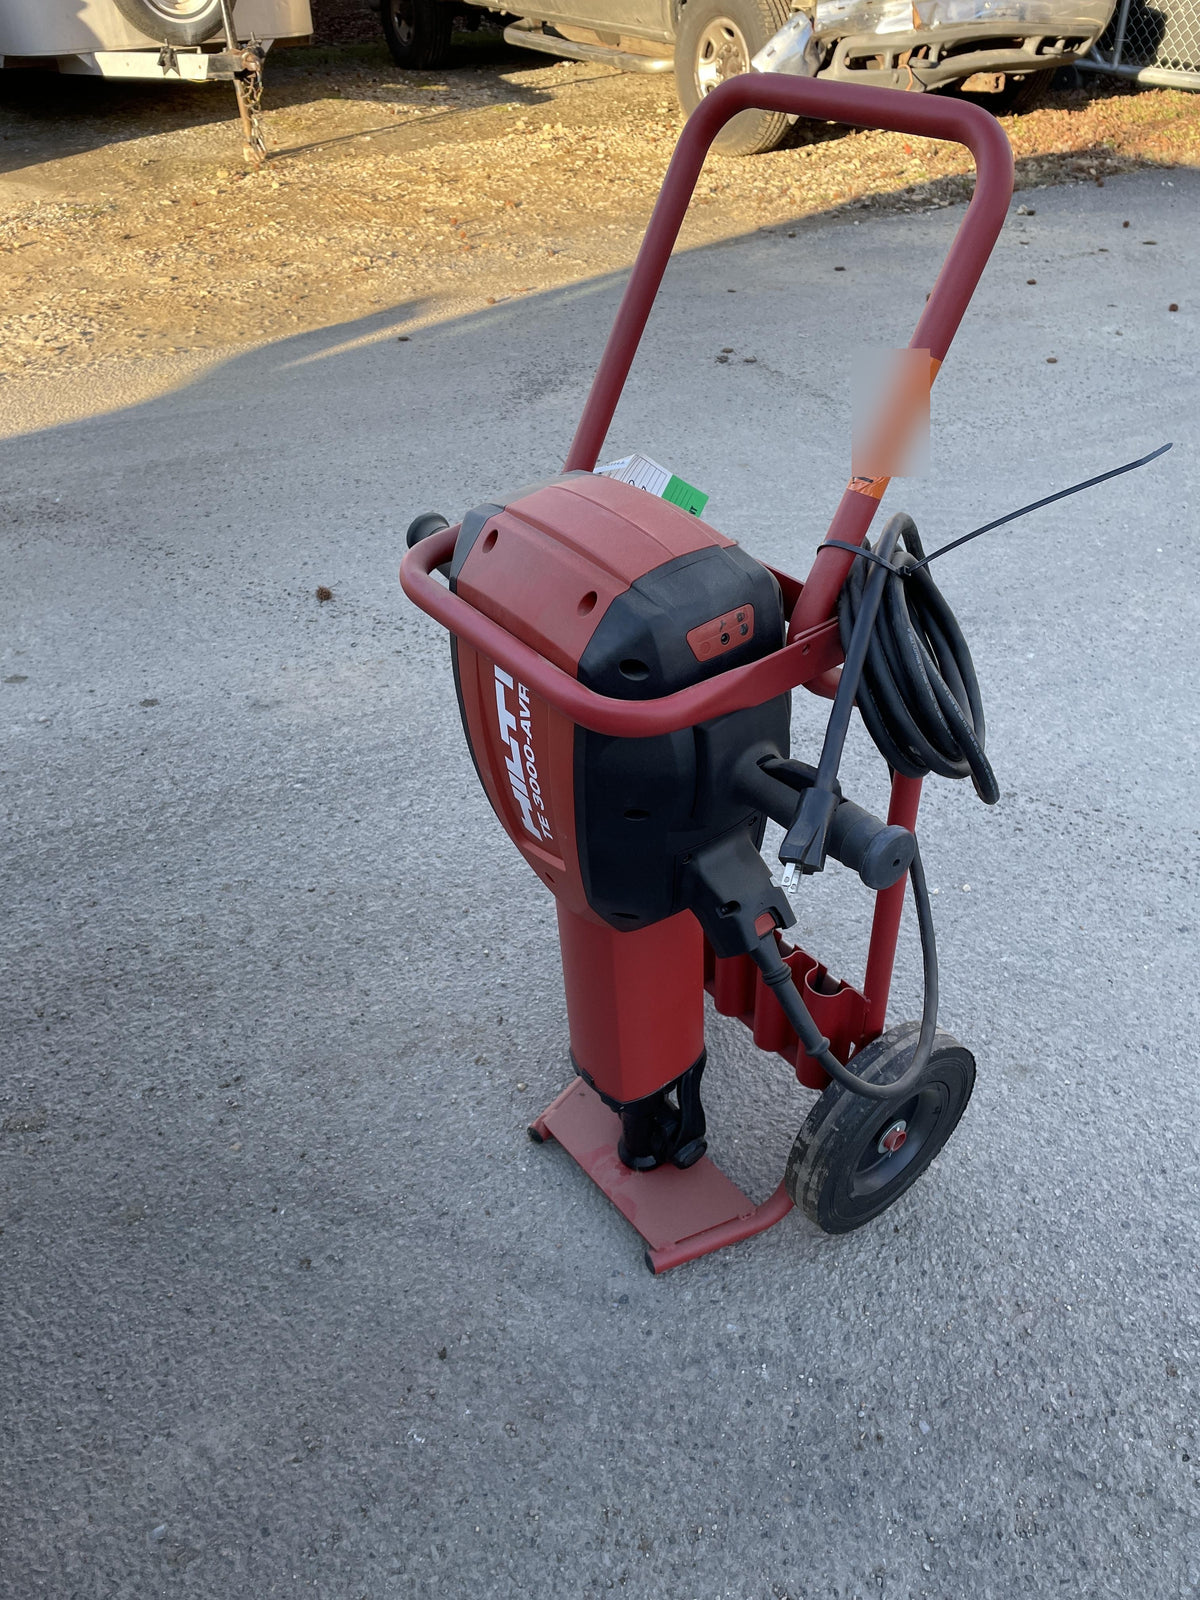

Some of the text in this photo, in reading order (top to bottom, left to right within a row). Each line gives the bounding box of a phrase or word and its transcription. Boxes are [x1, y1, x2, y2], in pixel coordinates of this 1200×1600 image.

[494, 664, 543, 842] HILTI
[518, 682, 554, 841] TE 3000-AVR
